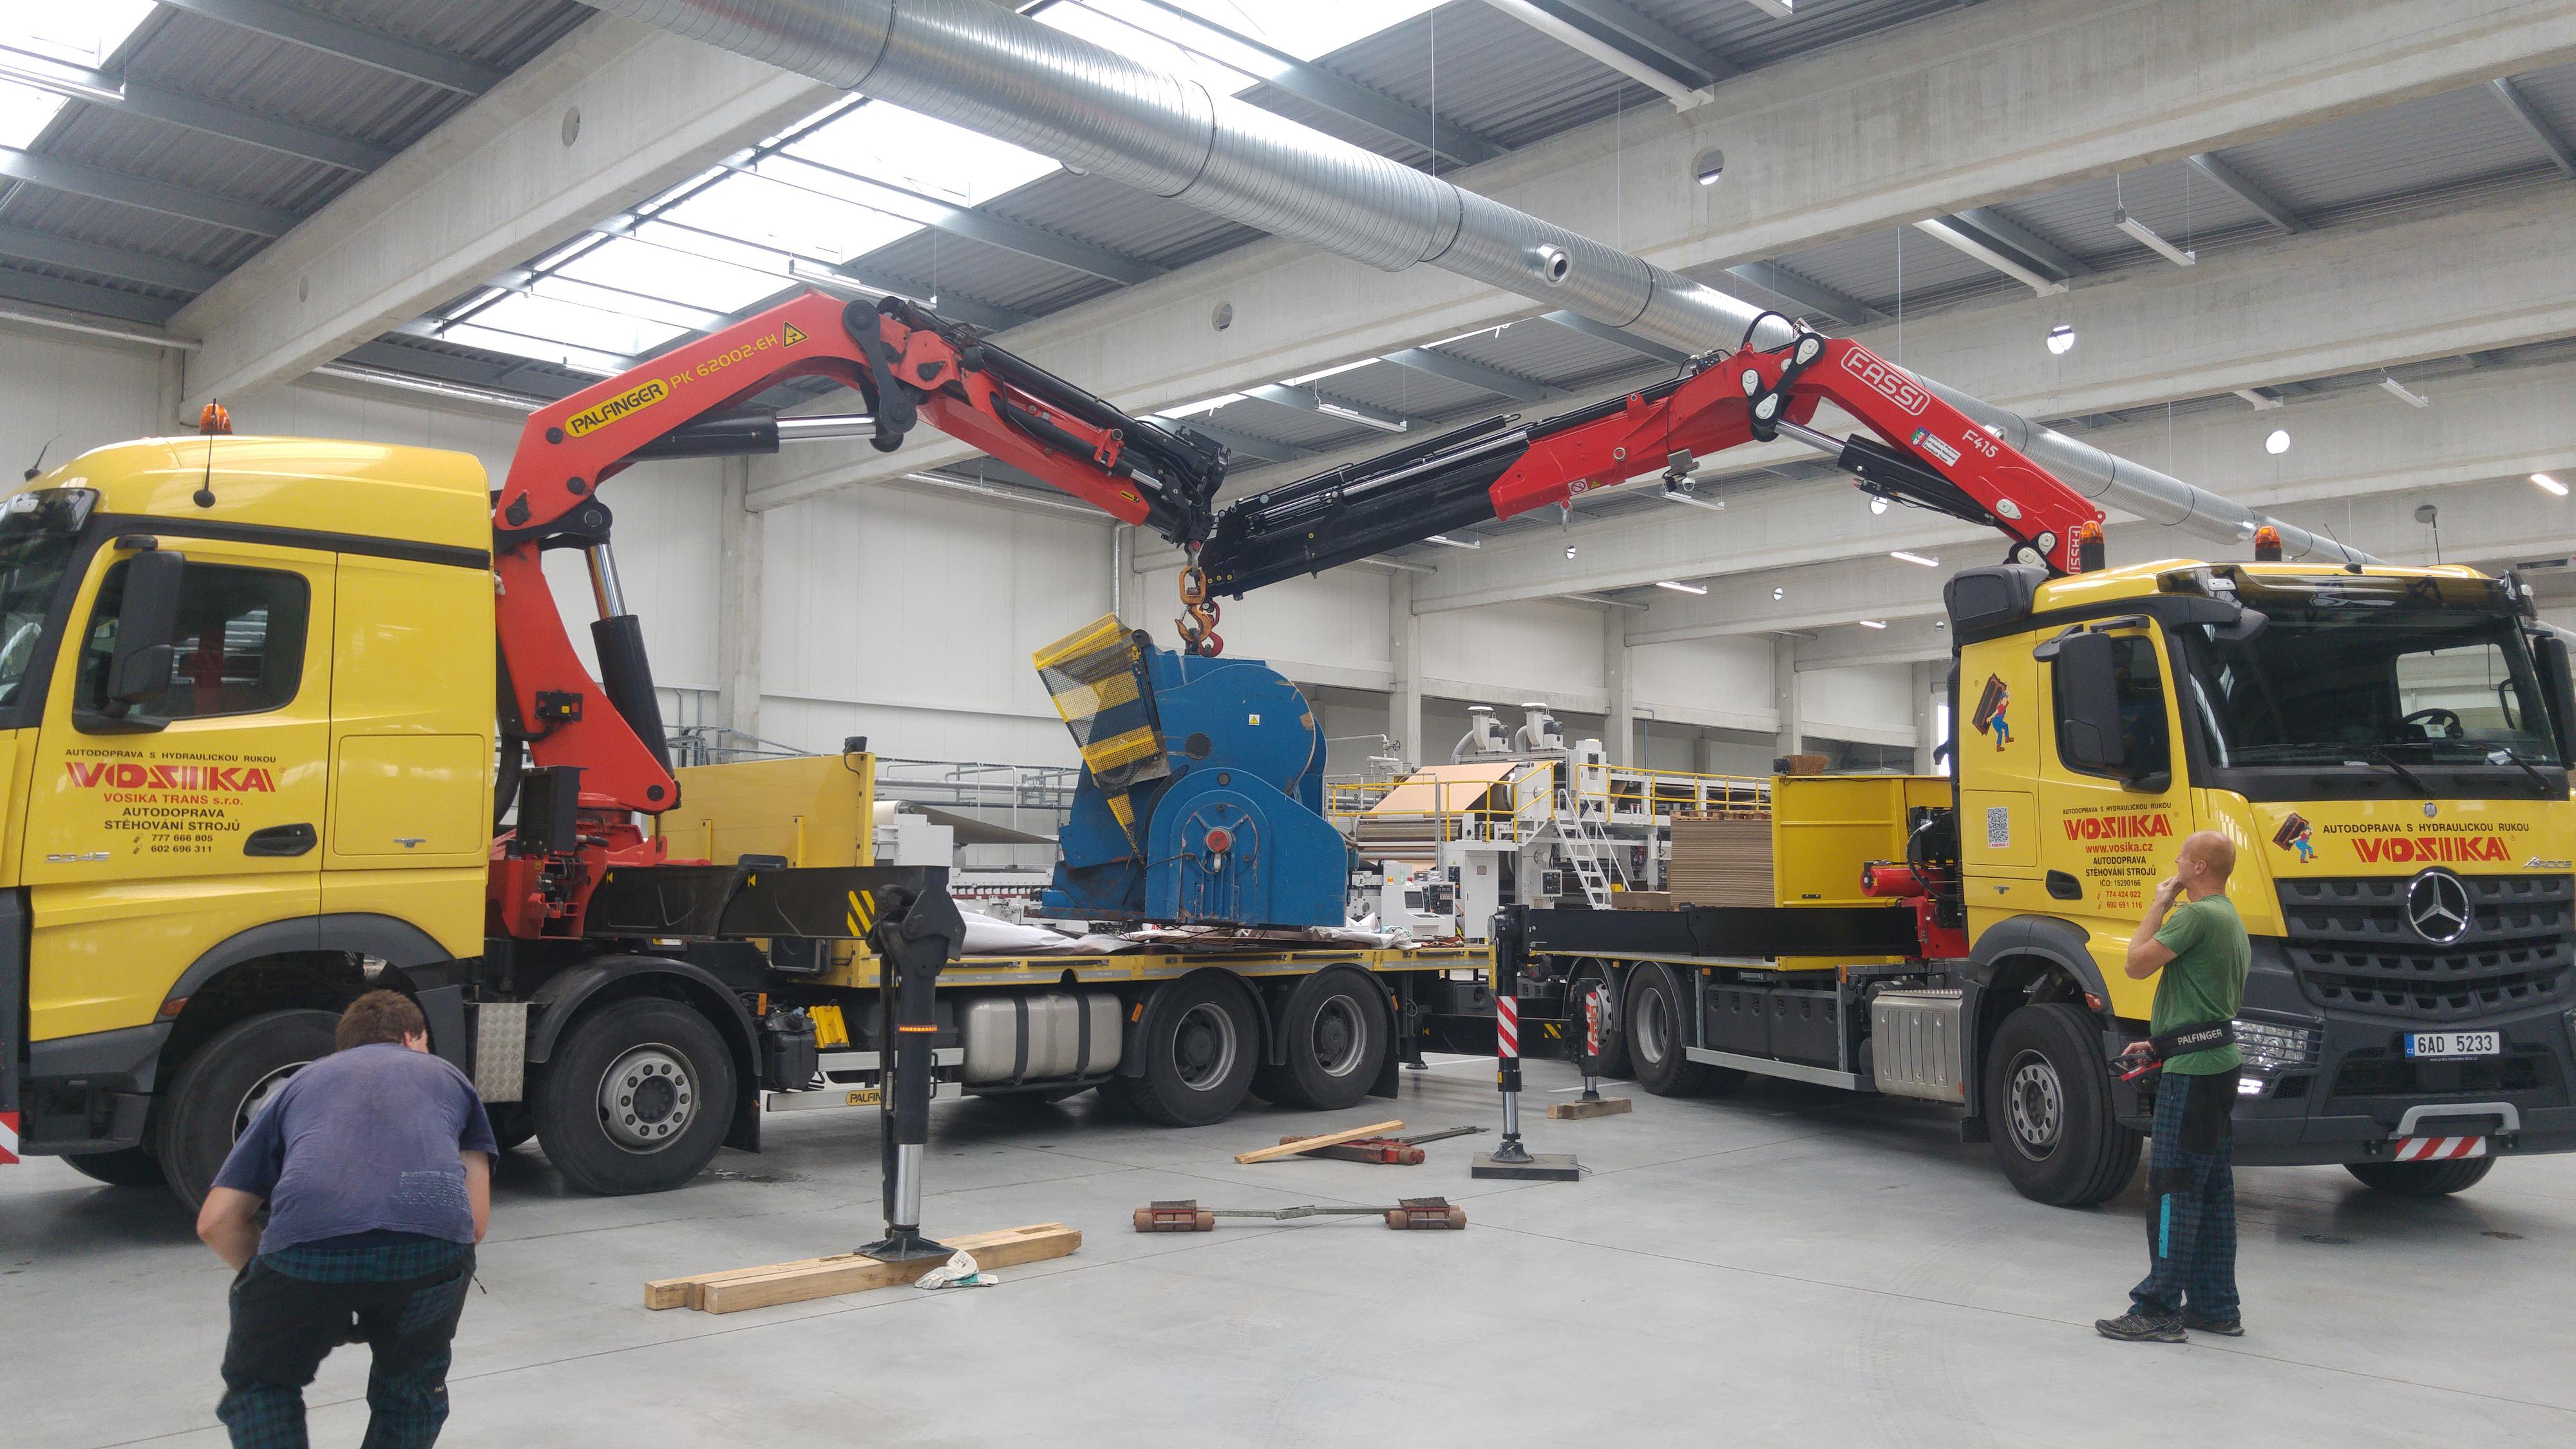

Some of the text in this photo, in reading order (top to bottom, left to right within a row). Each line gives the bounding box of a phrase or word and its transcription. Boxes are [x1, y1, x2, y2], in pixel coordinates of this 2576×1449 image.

[669, 333, 779, 389] PK 62002-EH
[1847, 352, 1924, 410] FASSI
[571, 384, 663, 433] PALFINGER
[1962, 429, 1999, 458] F415
[65, 748, 144, 758] AUTODOPRAVA
[162, 752, 238, 762] HYDRAULICKOU
[243, 755, 276, 763] RUKOU
[65, 762, 276, 793] VOSIKA
[104, 793, 243, 806] VOSIKA TRANS s.r.o.
[122, 808, 225, 818] AUTODOPRAVA
[2106, 803, 2148, 811] HYDRAULICKOU
[104, 819, 241, 831] STĚHOVÁNÍ STROJŮ
[2063, 813, 2173, 840] VOSIKA
[2323, 822, 2530, 834] AUTODOPRAVA S HYDRAULICKOU RUKOU
[173, 845, 191, 853] 696
[194, 845, 212, 853] 311
[2085, 842, 2154, 854] www.vosika.cz
[2351, 837, 2512, 863] VOSIKA
[2093, 856, 2146, 865] AUTODOPRAVA
[2085, 864, 2156, 876] STĚHOVÁNÍ STROJŮ
[2099, 878, 2112, 887] IČO:
[2177, 1028, 2222, 1045] PALFINGER
[2418, 1035, 2492, 1054] 6AD 5233
[849, 1092, 882, 1103] PALFIN
